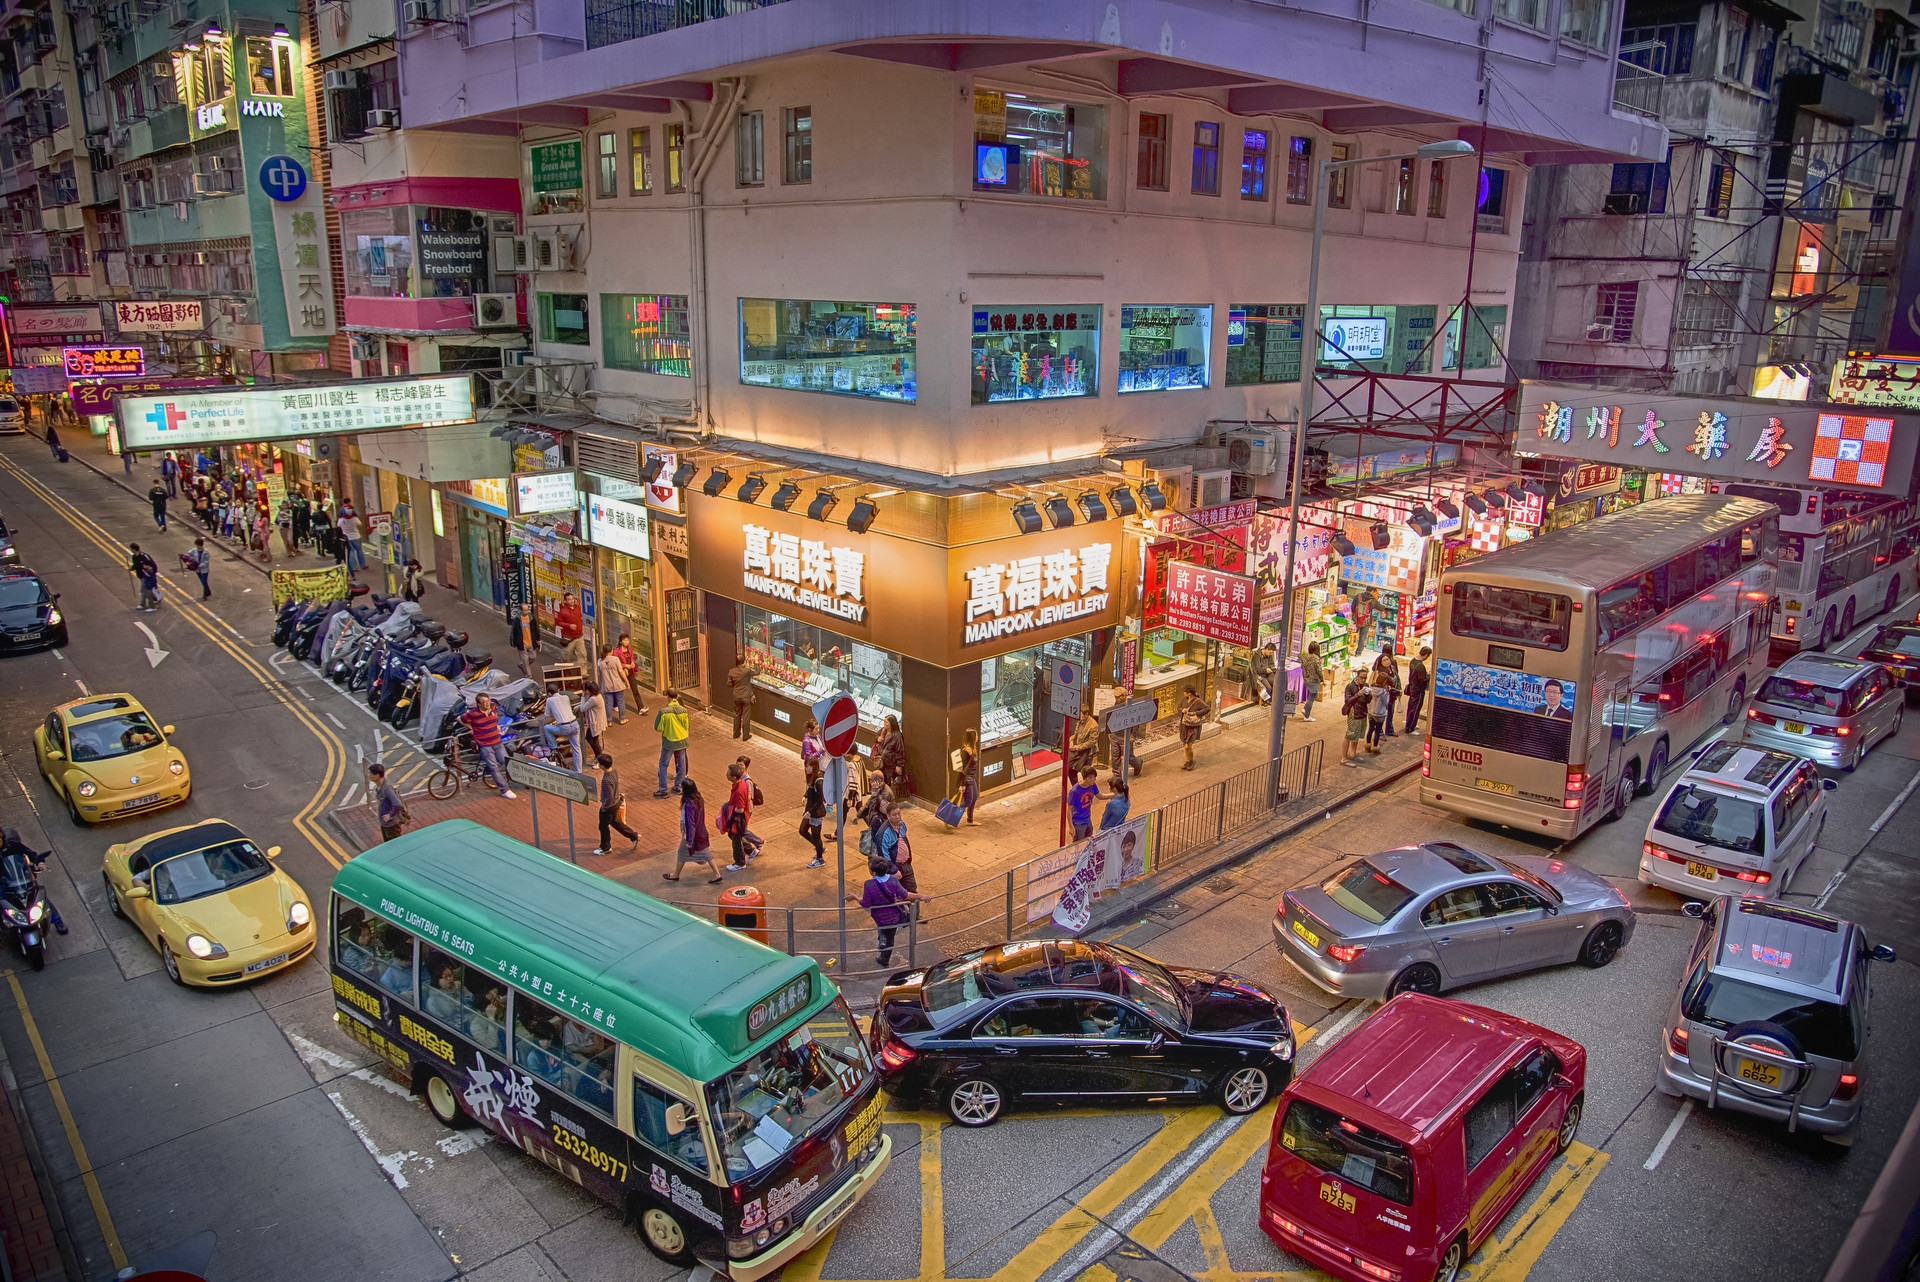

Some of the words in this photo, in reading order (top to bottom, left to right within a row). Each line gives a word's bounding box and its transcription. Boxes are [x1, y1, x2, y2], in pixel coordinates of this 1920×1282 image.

[242, 100, 285, 118] HAIR
[421, 234, 481, 245] Wakeboard
[423, 249, 483, 260] Snowboard
[425, 263, 472, 274] Freebord
[41, 336, 63, 344] SALON
[190, 400, 197, 408] A
[198, 398, 234, 408] Member
[234, 397, 243, 406] of
[281, 391, 360, 410] 黃國川醫生
[375, 384, 447, 403] 楊志峰醫生
[190, 408, 226, 419] Perfect
[227, 406, 245, 417] Life
[1537, 400, 1794, 468] 潮州大藥房
[742, 523, 865, 602] 萬福珠寶
[966, 542, 1112, 624] 萬福珠寶
[1176, 568, 1247, 603] 許氏兄弟
[583, 592, 593, 613] P
[743, 571, 797, 602] MANFOOK
[796, 587, 865, 622] JEWELLERY
[1169, 589, 1251, 624] 外幣找換有限公司
[965, 611, 1034, 644] MANFOOK
[1035, 593, 1110, 627] JEWELLERY
[1180, 608, 1197, 620] Brothers
[1197, 612, 1212, 624] Foreign
[1212, 616, 1231, 629] Exchange
[1241, 623, 1250, 633] Ltd.
[1179, 618, 1192, 630] 2393
[1192, 621, 1206, 633] 8819
[1221, 629, 1235, 641] 2393
[1235, 632, 1249, 644] 3783
[1070, 692, 1075, 700] 7
[1522, 682, 1543, 694] 物理
[1520, 694, 1542, 704] SHAM
[1070, 706, 1078, 715] 12
[1115, 710, 1128, 718] Mong
[1139, 703, 1150, 711] Road
[1123, 716, 1142, 726] 旺角道
[1451, 747, 1483, 766] KMB
[547, 772, 563, 782] Street
[564, 777, 580, 788] South
[1480, 780, 1490, 788] JA
[1491, 782, 1511, 792] 3907
[125, 800, 137, 809] RZ
[138, 795, 159, 806] 7895
[380, 898, 405, 919] PUBLIC
[405, 910, 439, 937] LIGHTBUS
[441, 929, 450, 942] 16
[451, 935, 475, 956] SEATS
[247, 963, 263, 973] MC
[264, 954, 287, 969] 4021
[498, 959, 617, 1029] 公共小型巴士十六座位
[399, 1014, 456, 1066] 費用全免
[1752, 1062, 1769, 1073] MY
[1742, 1070, 1777, 1084] 6627
[464, 1051, 545, 1149] 戒煙
[552, 1124, 628, 1183] 23328977
[1322, 1190, 1353, 1212] 8783
[816, 1217, 831, 1232] LY
